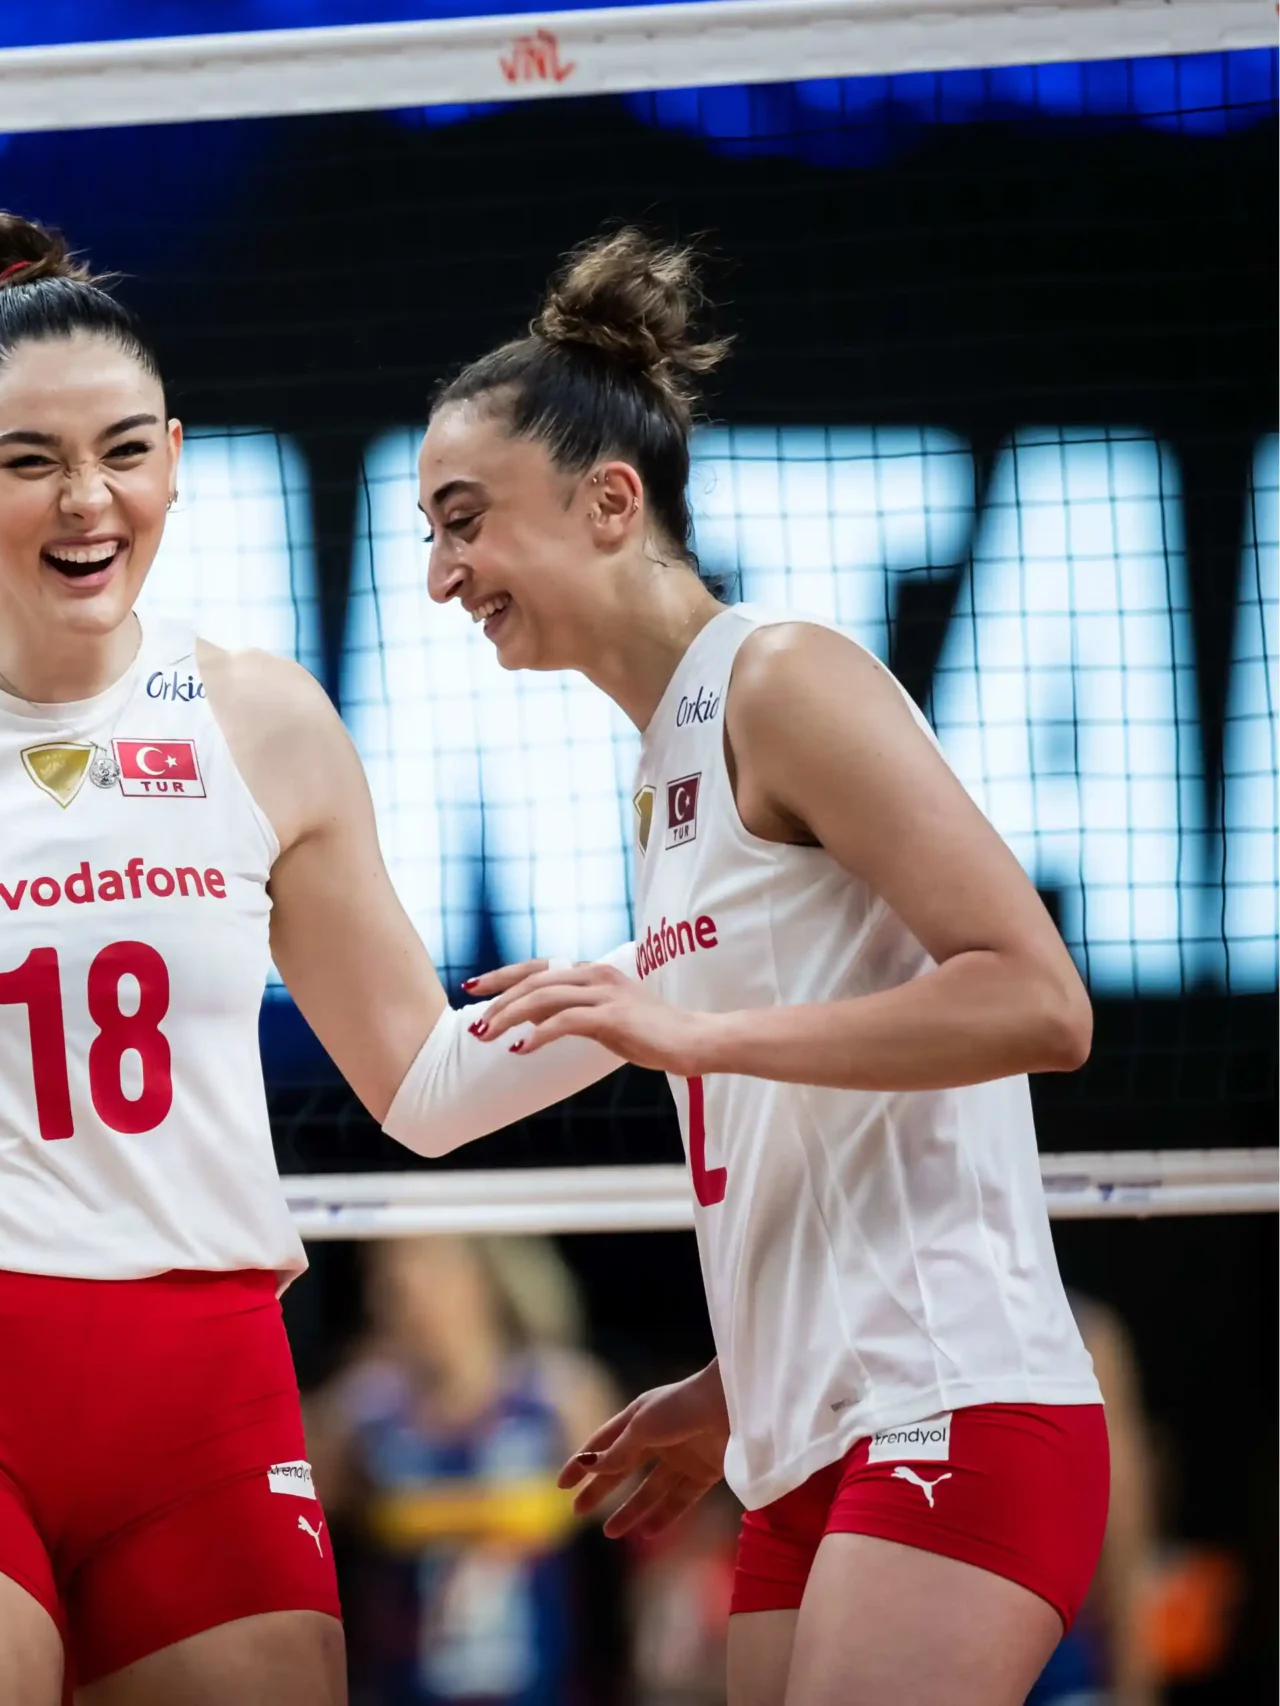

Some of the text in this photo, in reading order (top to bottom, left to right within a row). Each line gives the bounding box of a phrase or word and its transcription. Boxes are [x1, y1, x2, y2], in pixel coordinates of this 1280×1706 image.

[140, 780, 185, 793] TUR
[673, 827, 690, 841] TUR
[635, 914, 718, 981] vodafone
[874, 1427, 946, 1446] trendyol
